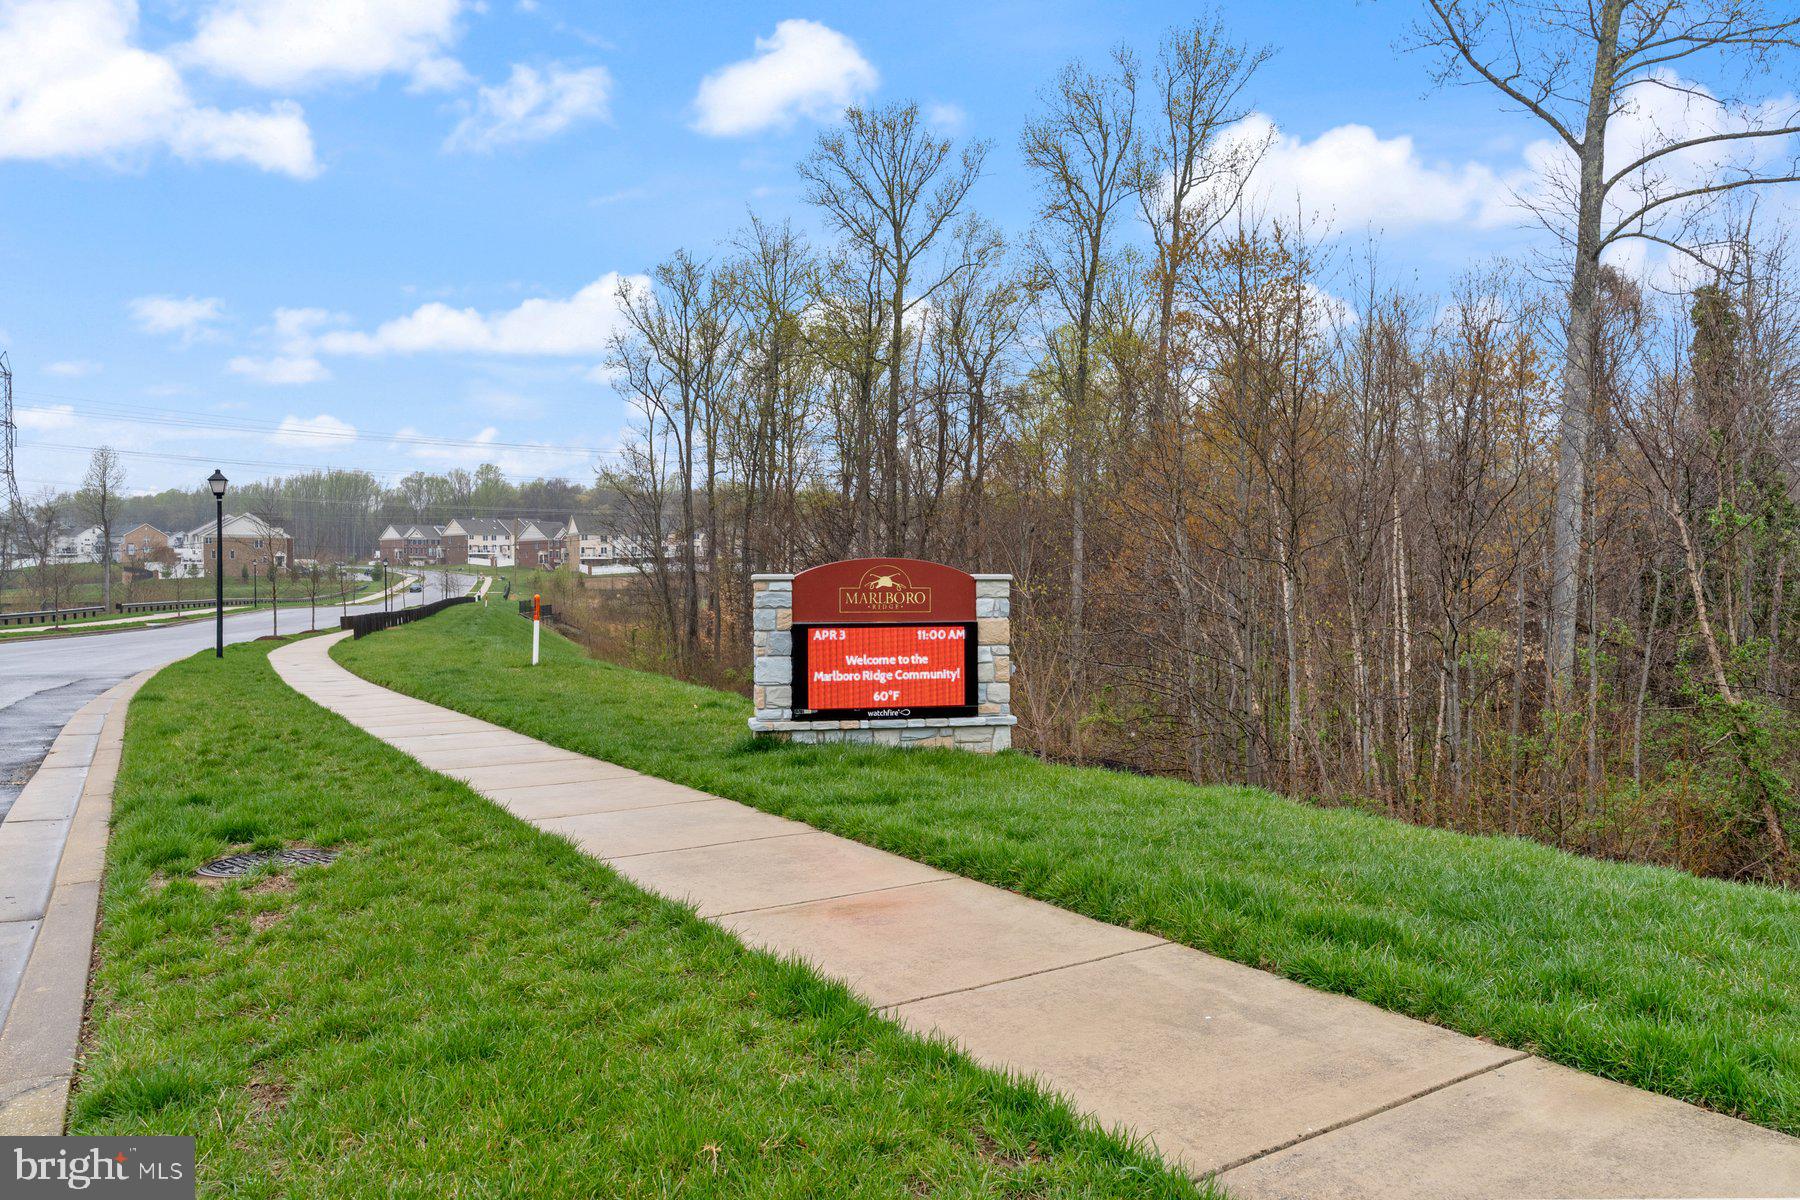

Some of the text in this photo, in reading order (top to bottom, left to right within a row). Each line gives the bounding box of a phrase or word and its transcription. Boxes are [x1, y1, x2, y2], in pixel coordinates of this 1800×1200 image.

[846, 591, 926, 604] MARLBORO
[813, 630, 846, 640] APR 3
[917, 630, 965, 640] 11:00 AM
[845, 654, 928, 666] Welcome to the
[813, 668, 960, 683] Marlboro Ridge Community!
[873, 690, 900, 701] 60°F
